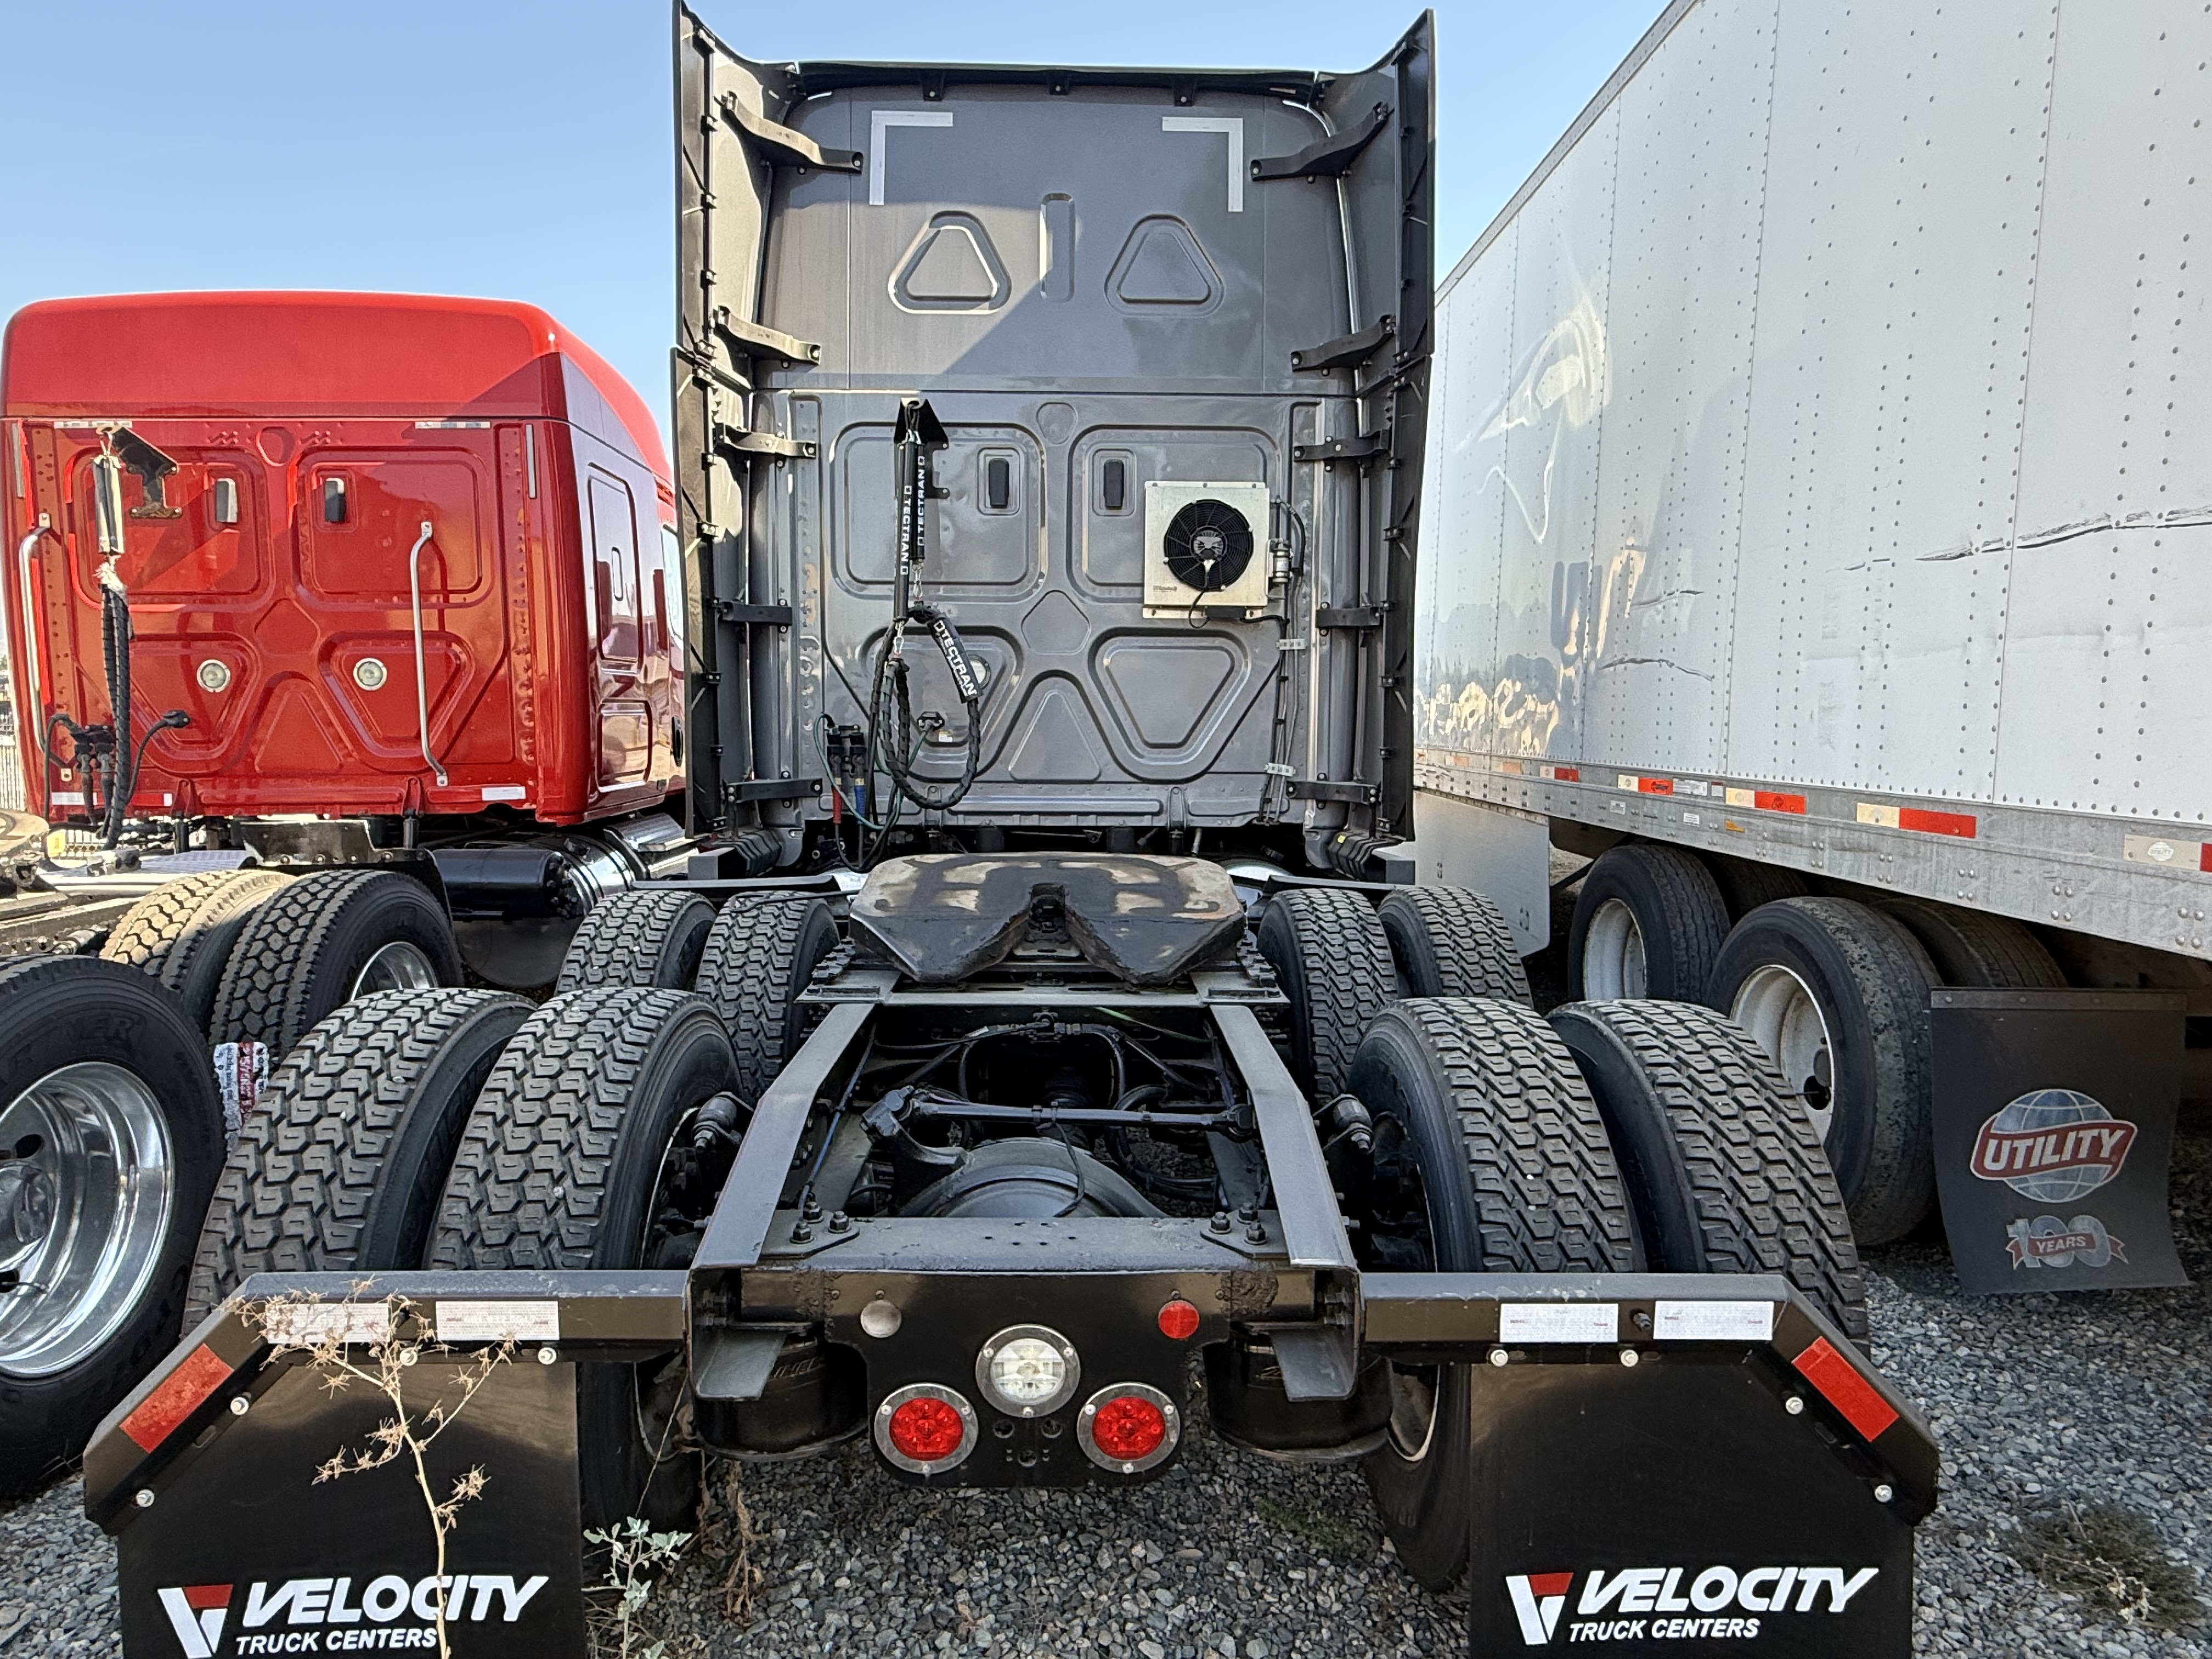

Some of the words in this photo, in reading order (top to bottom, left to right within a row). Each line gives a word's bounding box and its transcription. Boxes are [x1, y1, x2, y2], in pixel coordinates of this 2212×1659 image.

[900, 498, 912, 562] TECTRAN
[941, 629, 978, 696] TECTRAN
[1983, 1128, 2127, 1171] UTILITY
[2036, 1235, 2086, 1254] YEARS
[242, 1575, 549, 1627] VELOCITY
[1577, 1566, 1879, 1615] VELOCITY
[236, 1631, 320, 1656] TRUCK
[325, 1628, 438, 1651] CENTERS
[1569, 1619, 1646, 1643] TRUCK
[1651, 1617, 1760, 1639] CENTERS
